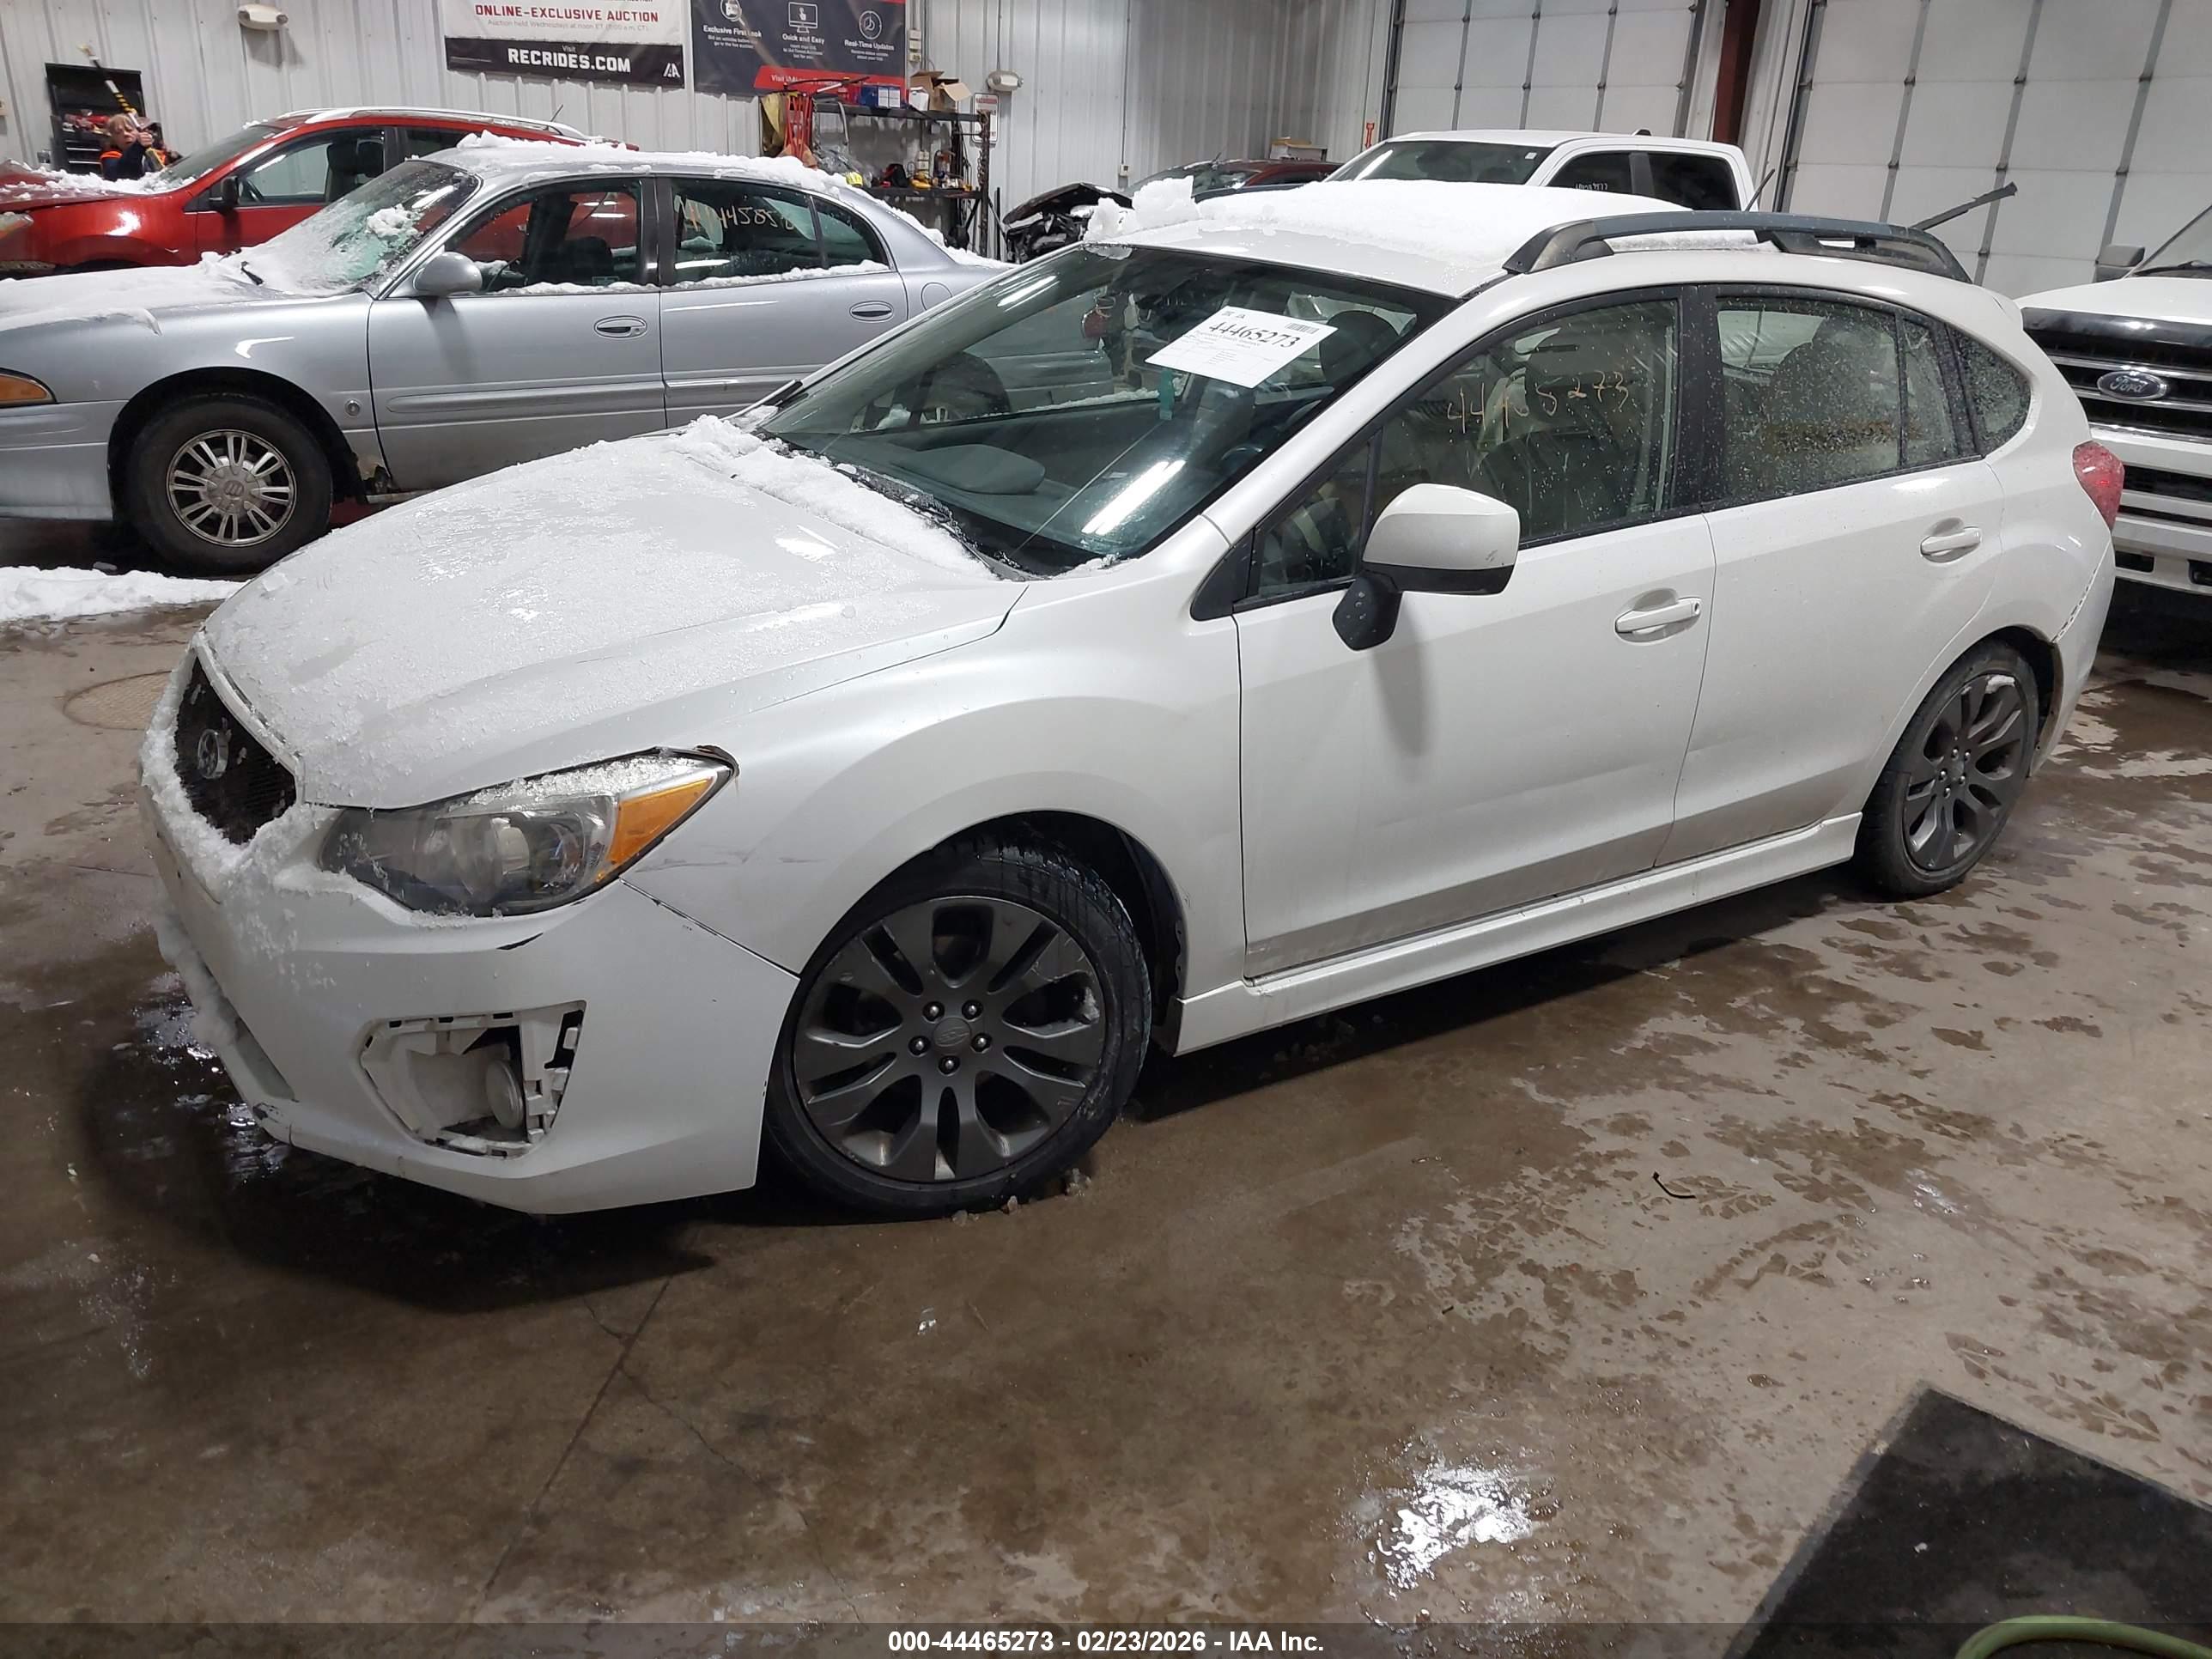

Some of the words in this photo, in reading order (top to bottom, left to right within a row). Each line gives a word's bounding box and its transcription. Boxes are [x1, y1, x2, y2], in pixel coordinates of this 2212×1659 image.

[475, 4, 603, 21] ONLINE-EXCLUSIVE
[607, 10, 659, 22] AUCTION
[703, 25, 732, 35] Exclusive
[782, 33, 799, 42] Quick
[811, 36, 824, 46] Easy
[844, 40, 872, 49] Real-Time
[874, 42, 895, 51] Updates
[507, 48, 630, 72] RECRIDES.COM
[1208, 321, 1301, 348] 44465273
[2110, 375, 2148, 392] Ford
